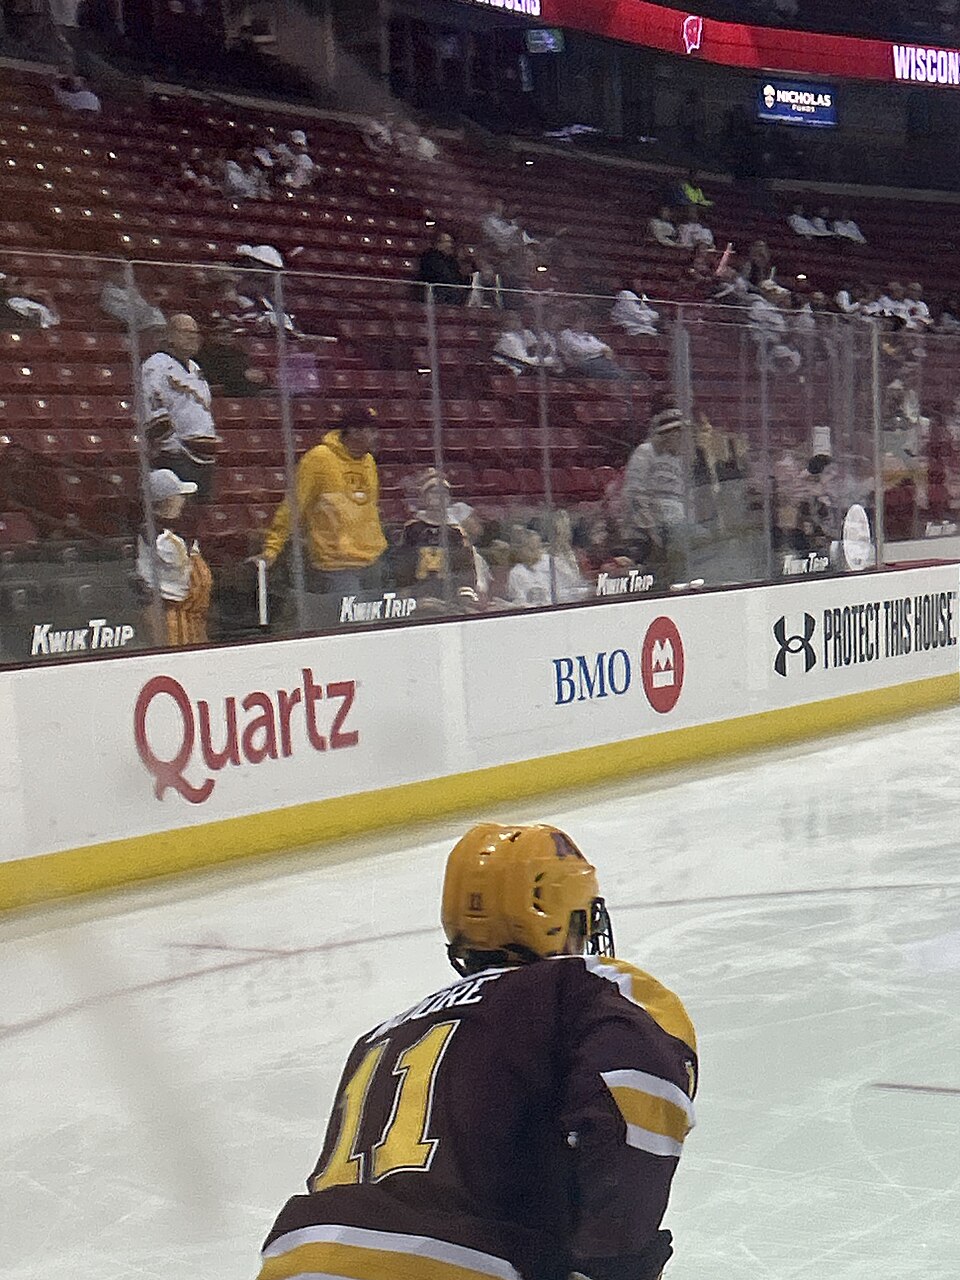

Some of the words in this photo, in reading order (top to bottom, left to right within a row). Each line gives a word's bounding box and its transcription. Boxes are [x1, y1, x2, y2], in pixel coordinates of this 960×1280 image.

[777, 90, 832, 107] NICHOLAS
[823, 602, 881, 669] PROTECT
[883, 597, 912, 658] THIS
[552, 649, 632, 705] BMO
[134, 668, 360, 804] Quartz
[307, 1020, 461, 1193] 11
